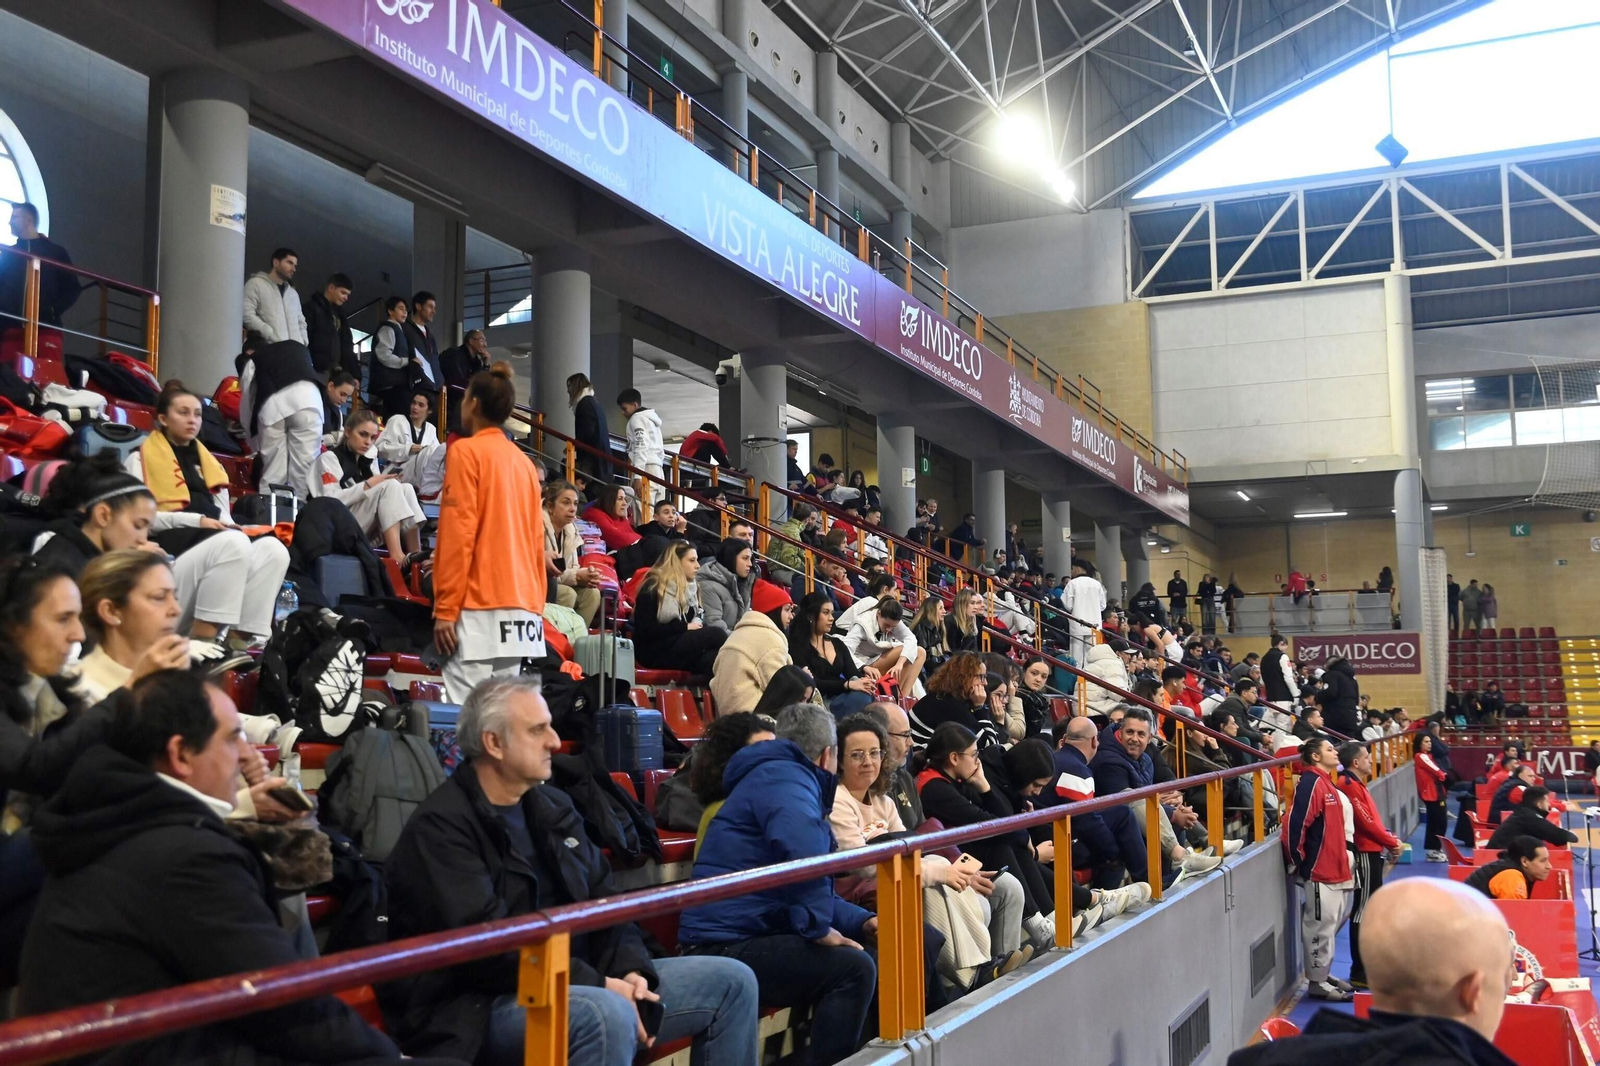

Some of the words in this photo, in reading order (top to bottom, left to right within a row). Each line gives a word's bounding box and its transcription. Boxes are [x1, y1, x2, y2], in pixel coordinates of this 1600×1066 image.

[446, 0, 630, 156] IMDECO
[663, 62, 669, 76] 4
[375, 24, 437, 78] Instituto
[440, 65, 507, 120] Municipal
[510, 109, 526, 131] de
[529, 118, 581, 164] Deportes
[856, 210, 860, 221] 5
[702, 190, 774, 276] VISTA
[780, 245, 861, 327] ALEGRE
[811, 238, 850, 274] DEPORTES
[920, 309, 983, 381] IMDECO
[900, 343, 920, 364] Instituto
[920, 354, 942, 378] Municipal
[942, 368, 948, 381] de
[947, 371, 966, 392] Deportes
[1082, 420, 1116, 466] IMDECO
[923, 457, 929, 472] D
[1515, 525, 1525, 535] K
[499, 620, 543, 643] FTCV
[1325, 642, 1416, 660] IMDECO
[1361, 662, 1389, 670] Deportes
